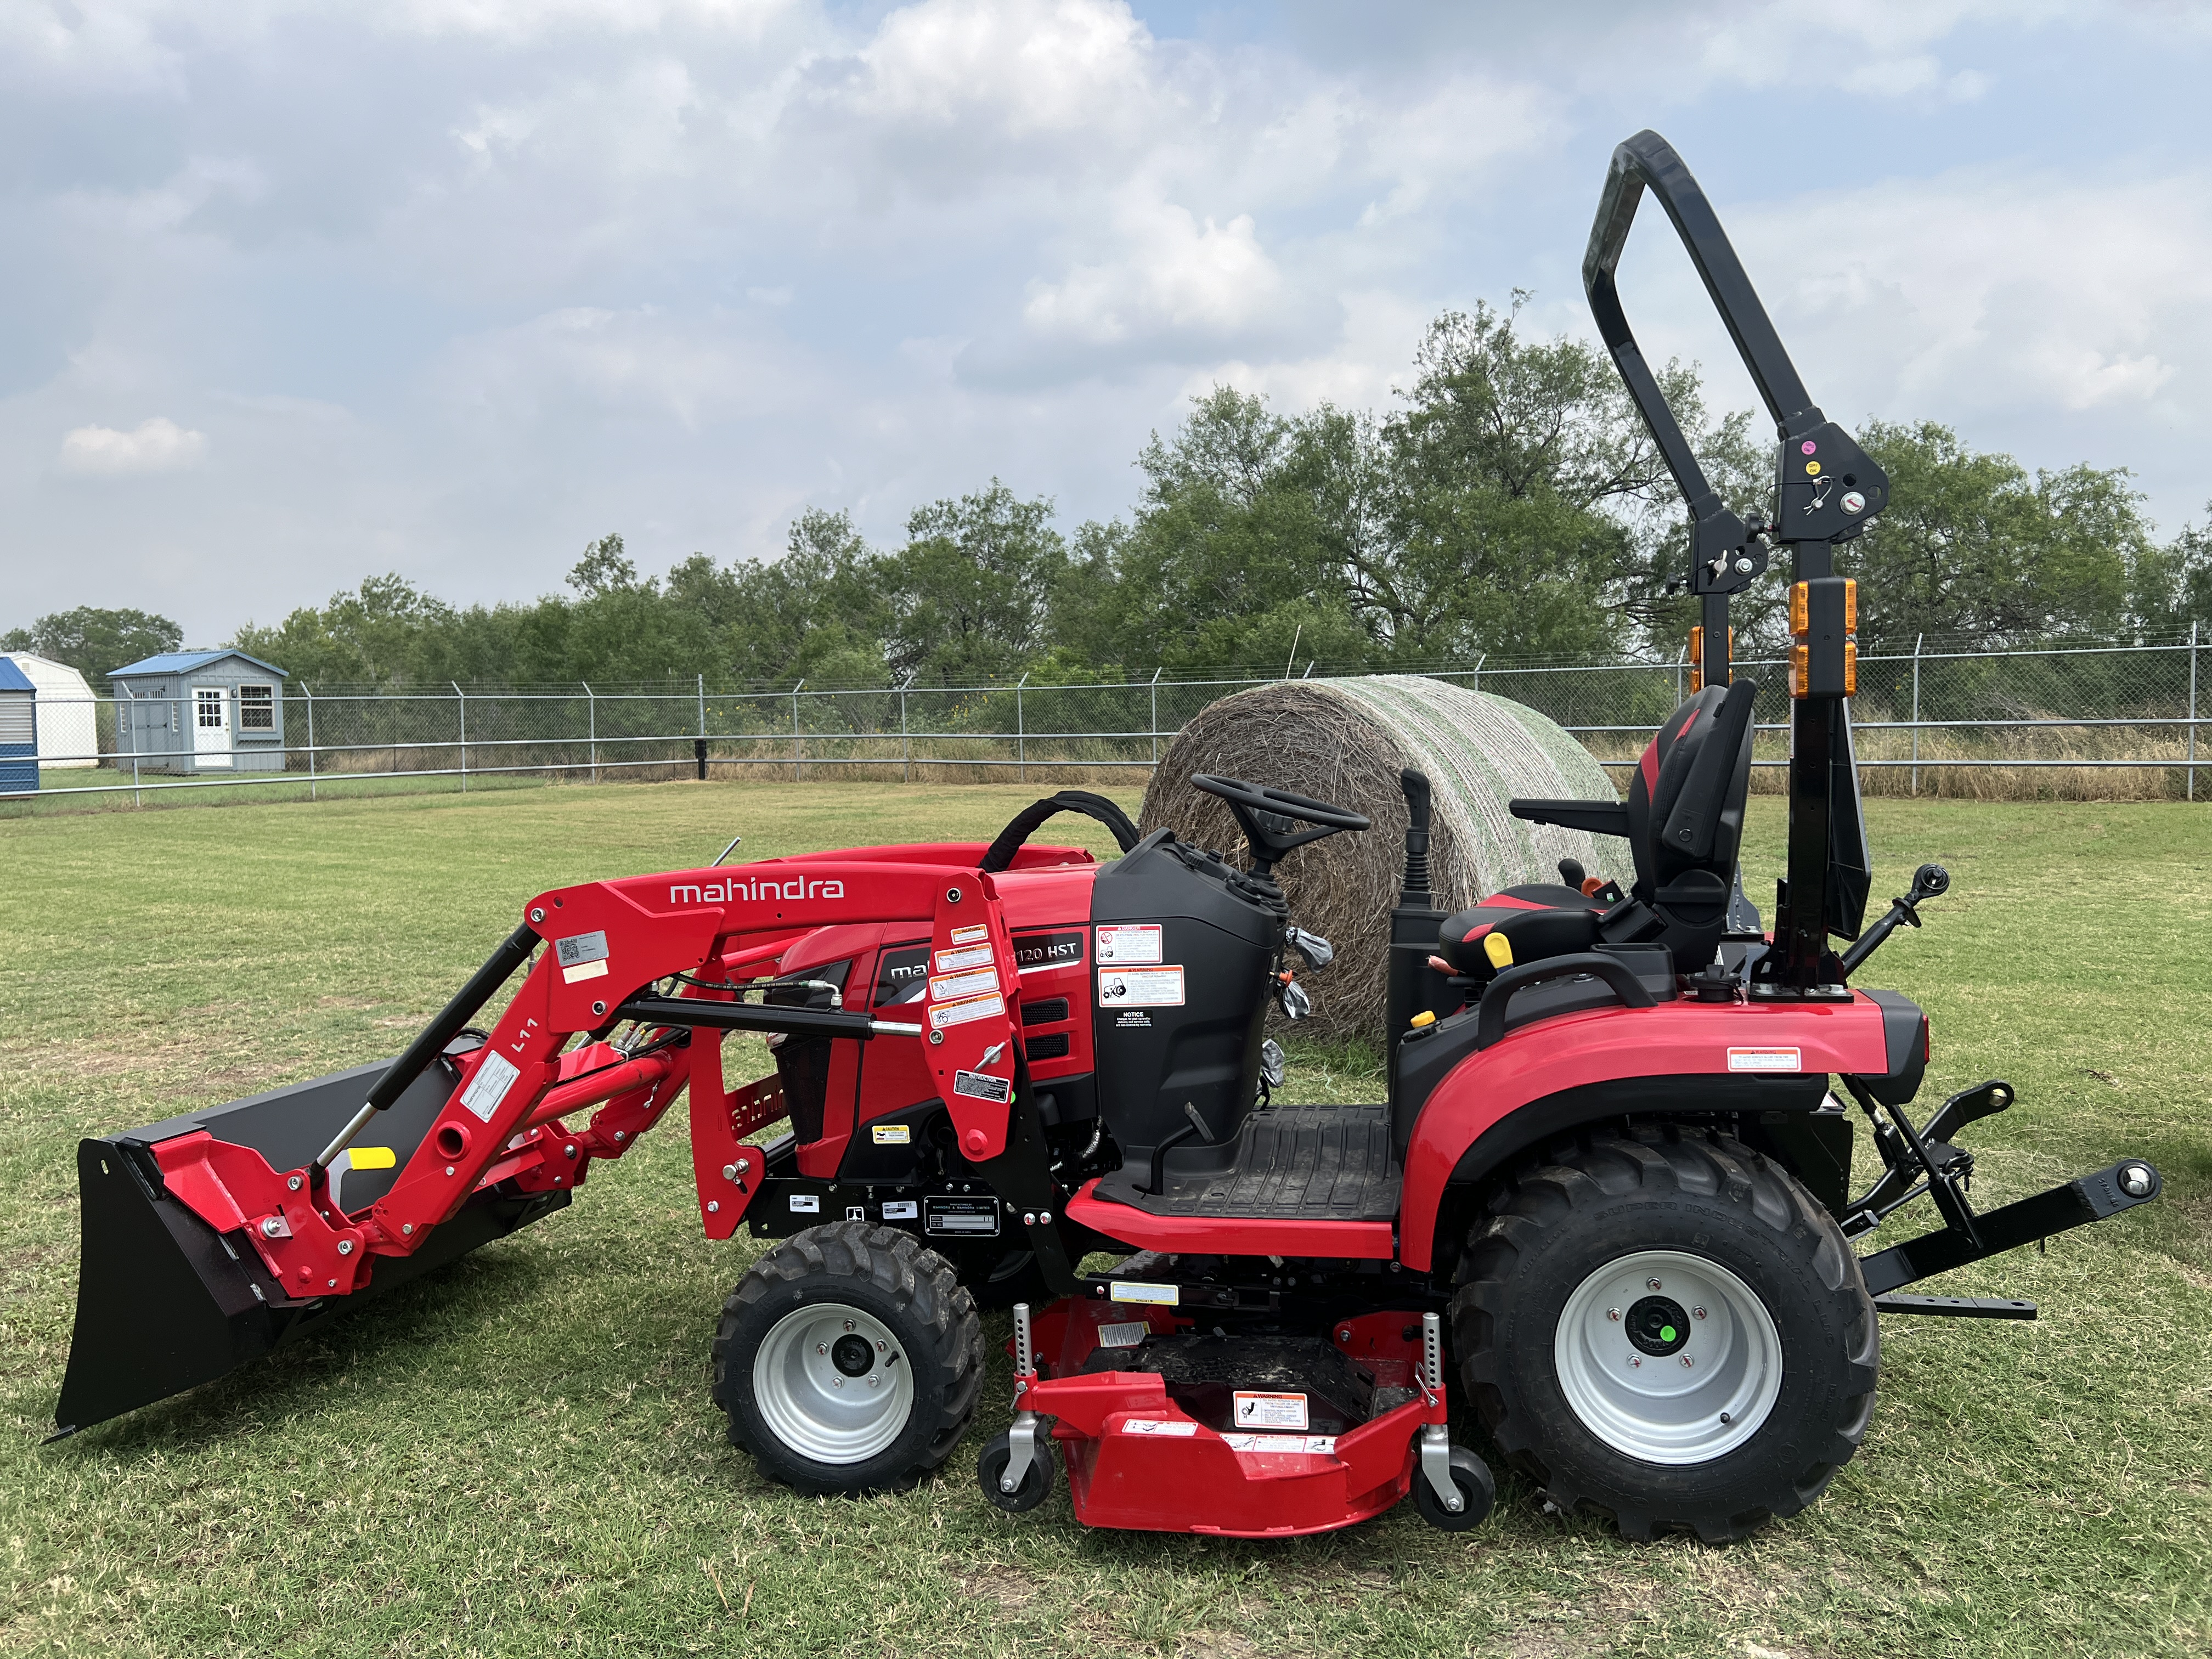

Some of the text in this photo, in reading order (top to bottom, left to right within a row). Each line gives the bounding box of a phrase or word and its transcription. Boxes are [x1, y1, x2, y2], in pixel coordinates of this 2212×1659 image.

[670, 875, 844, 904] mahindra
[1013, 942, 1076, 962] 120 HST
[511, 1018, 538, 1053] L11
[969, 1074, 997, 1082] INSTRUCTION
[467, 1086, 481, 1105] mahindra
[1593, 1201, 1836, 1347] SUPER INDUSTRIAL LUG
